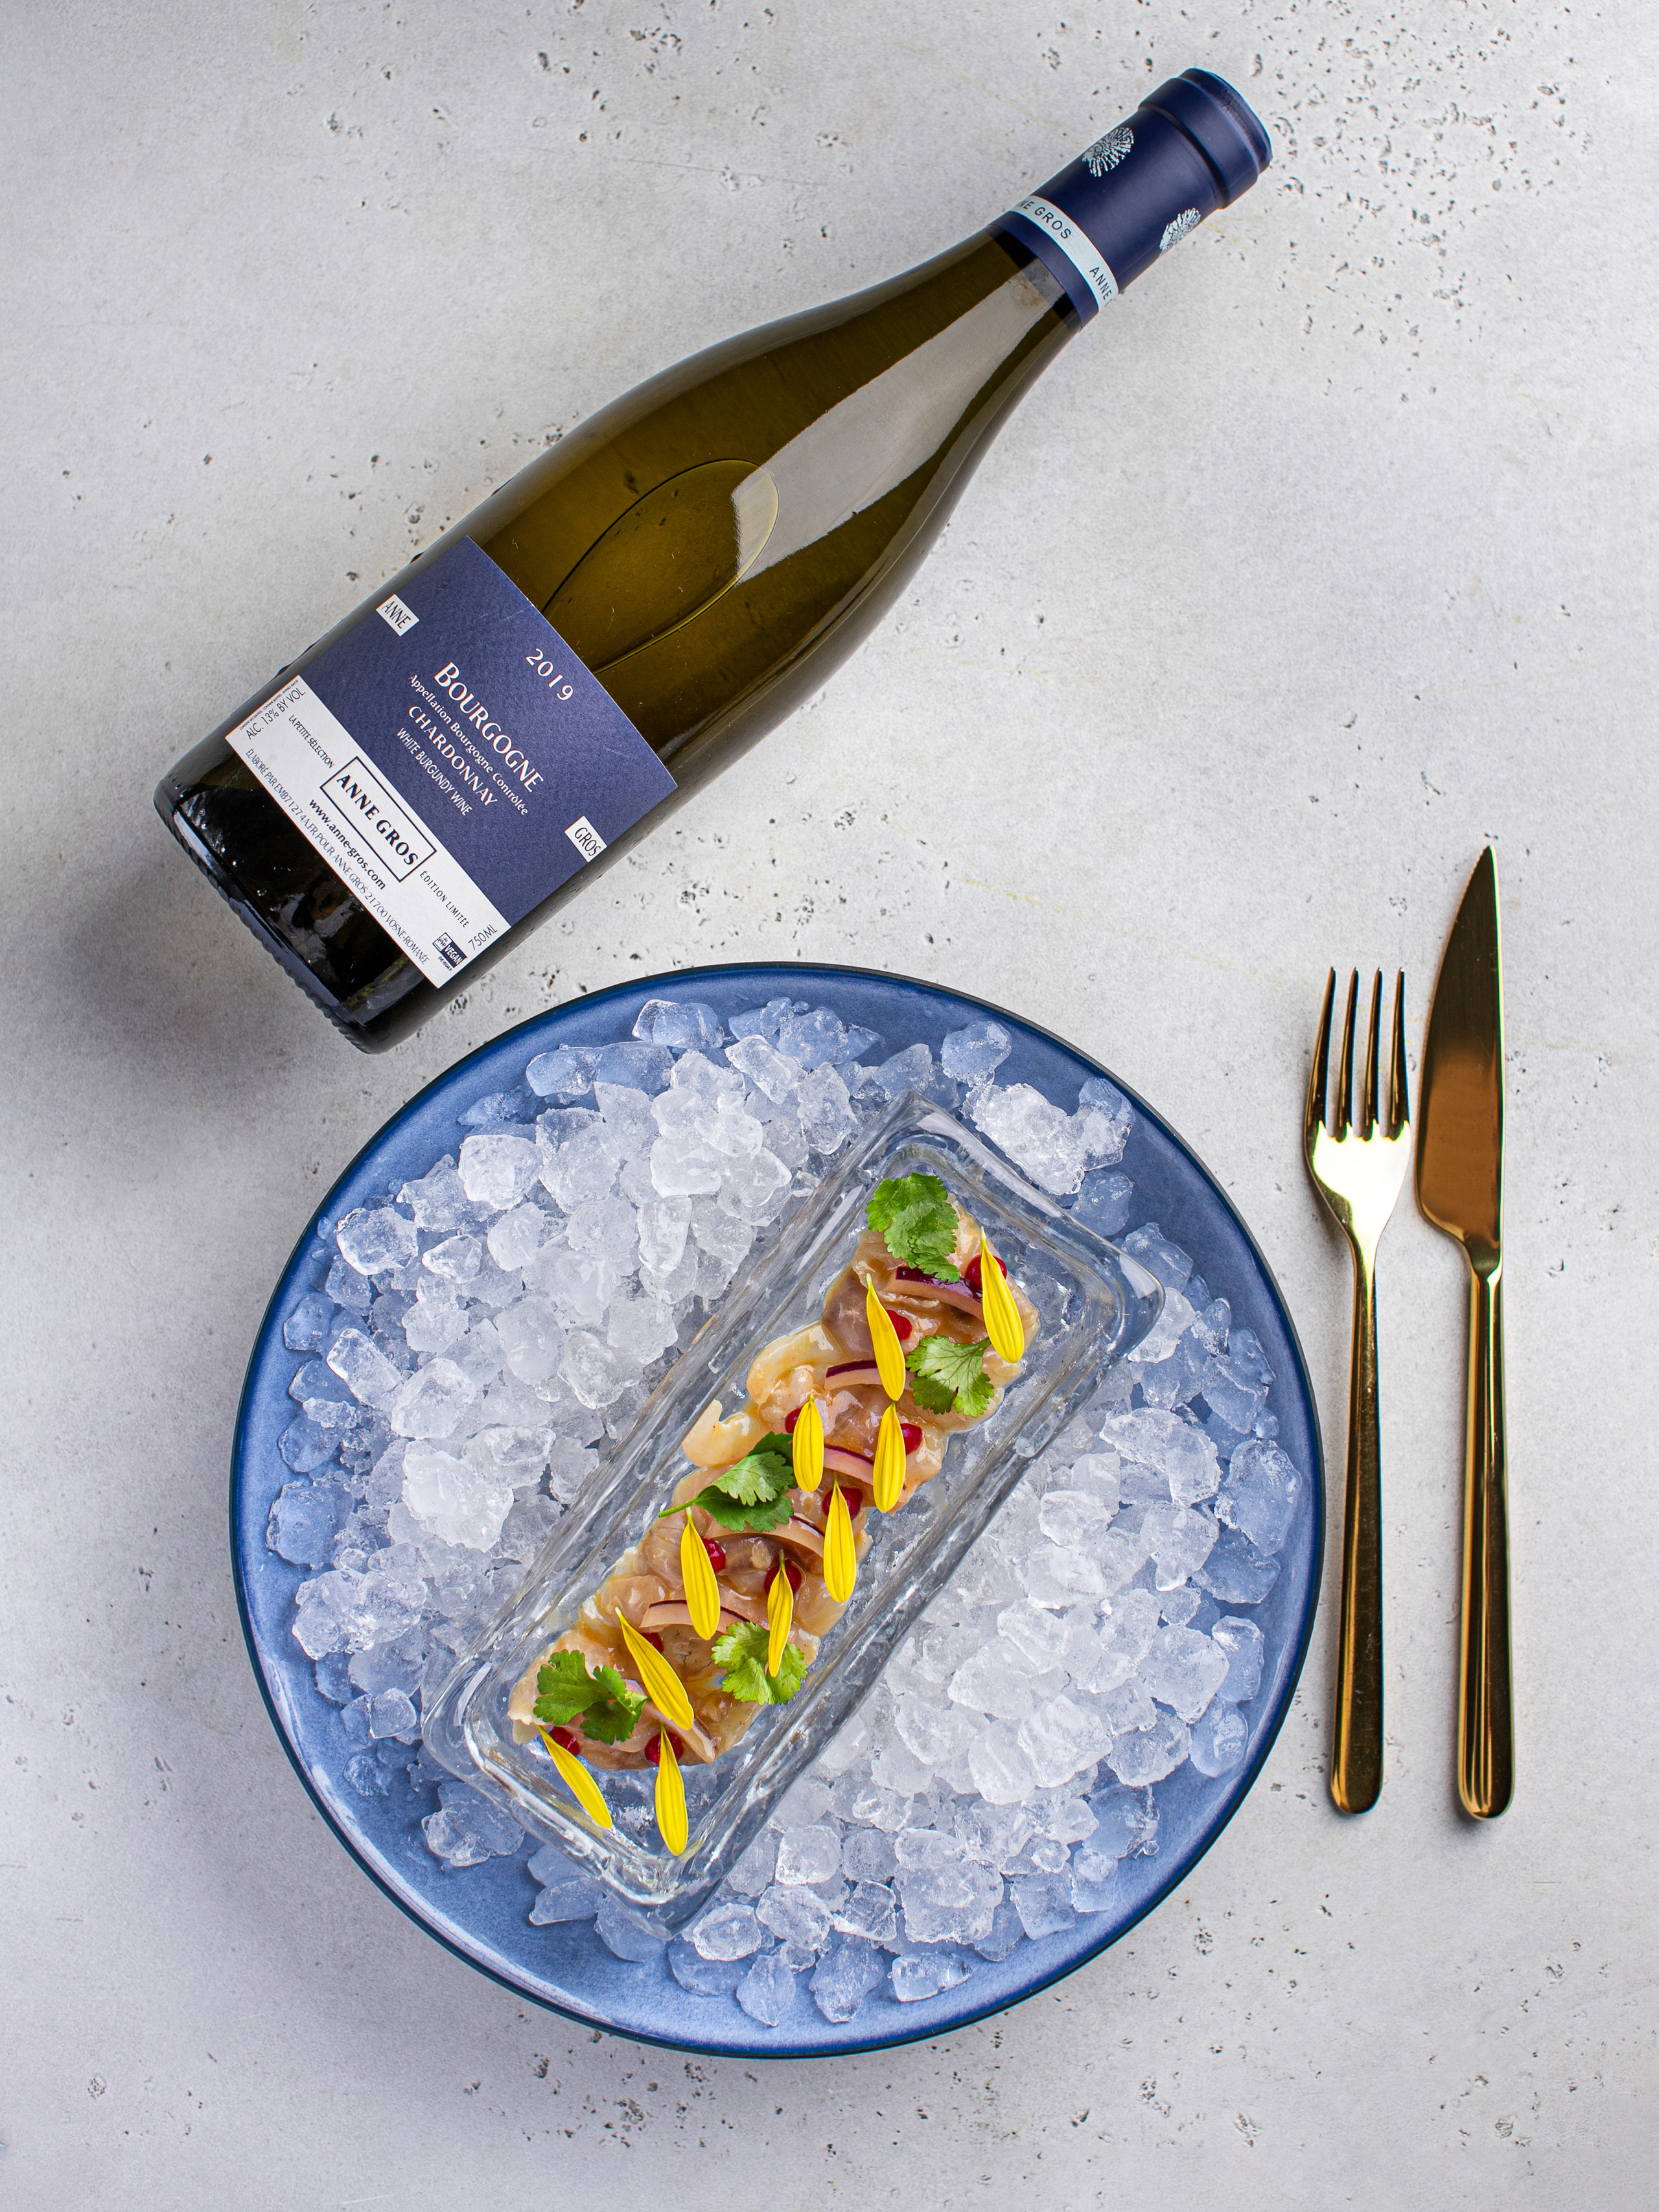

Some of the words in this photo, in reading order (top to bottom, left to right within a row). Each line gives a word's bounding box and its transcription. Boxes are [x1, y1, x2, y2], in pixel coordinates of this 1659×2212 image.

[1034, 207, 1071, 239] GROS
[1089, 266, 1112, 300] ANNE
[384, 600, 412, 629] ANNE
[526, 647, 574, 701] 2019
[246, 722, 264, 740] ALC.
[261, 708, 279, 725] 13%
[276, 698, 288, 713] BY
[285, 687, 306, 703] VOL.
[434, 662, 544, 793] BOURGOGNE
[288, 714, 297, 725] LA
[293, 721, 311, 740] PETITE
[307, 737, 334, 769] SÉLECTION
[408, 706, 498, 806] CHARDONNAY
[410, 674, 452, 725] Appellation
[450, 721, 493, 773] Bourgogne
[492, 773, 528, 815] Contrôlée
[397, 727, 421, 754] WHITE
[415, 751, 455, 793] BURGUNDY
[450, 791, 472, 816] WINE
[308, 798, 386, 890] www.anne-gros.com
[336, 774, 380, 821] ANNE
[376, 819, 419, 865] GROS
[574, 827, 601, 857] GROS
[245, 748, 269, 775] ÉLABORÉ
[264, 771, 277, 787] PAR
[314, 832, 335, 856] POUR
[334, 854, 353, 874] ANNE
[349, 873, 369, 894] GROS
[364, 892, 388, 918] 21700
[385, 914, 430, 965] VOSNE-ROMANÉE
[419, 870, 448, 902] ÉDITION
[445, 901, 469, 928] LIMITÉE
[444, 944, 463, 965] VEGAN
[467, 924, 498, 951] 750ML
